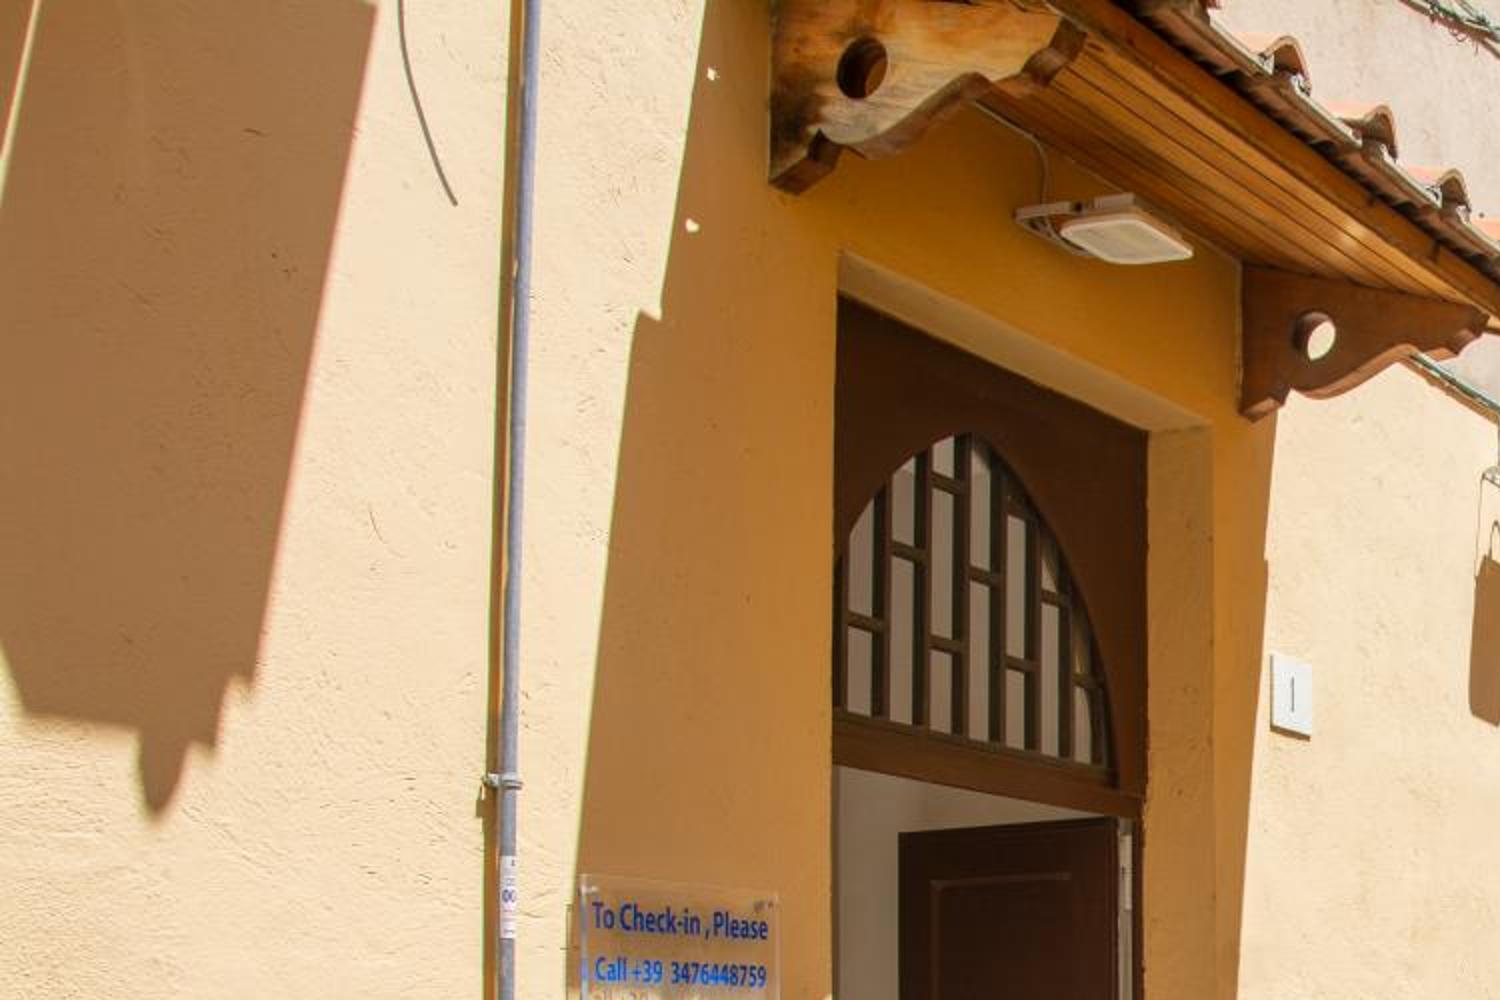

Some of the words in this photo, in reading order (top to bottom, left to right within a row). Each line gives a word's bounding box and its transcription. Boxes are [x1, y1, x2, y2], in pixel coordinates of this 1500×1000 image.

[592, 902, 614, 929] To
[713, 911, 768, 940] Please
[594, 957, 627, 982] Call
[632, 960, 663, 984] +39
[671, 961, 767, 988] 3476448759
